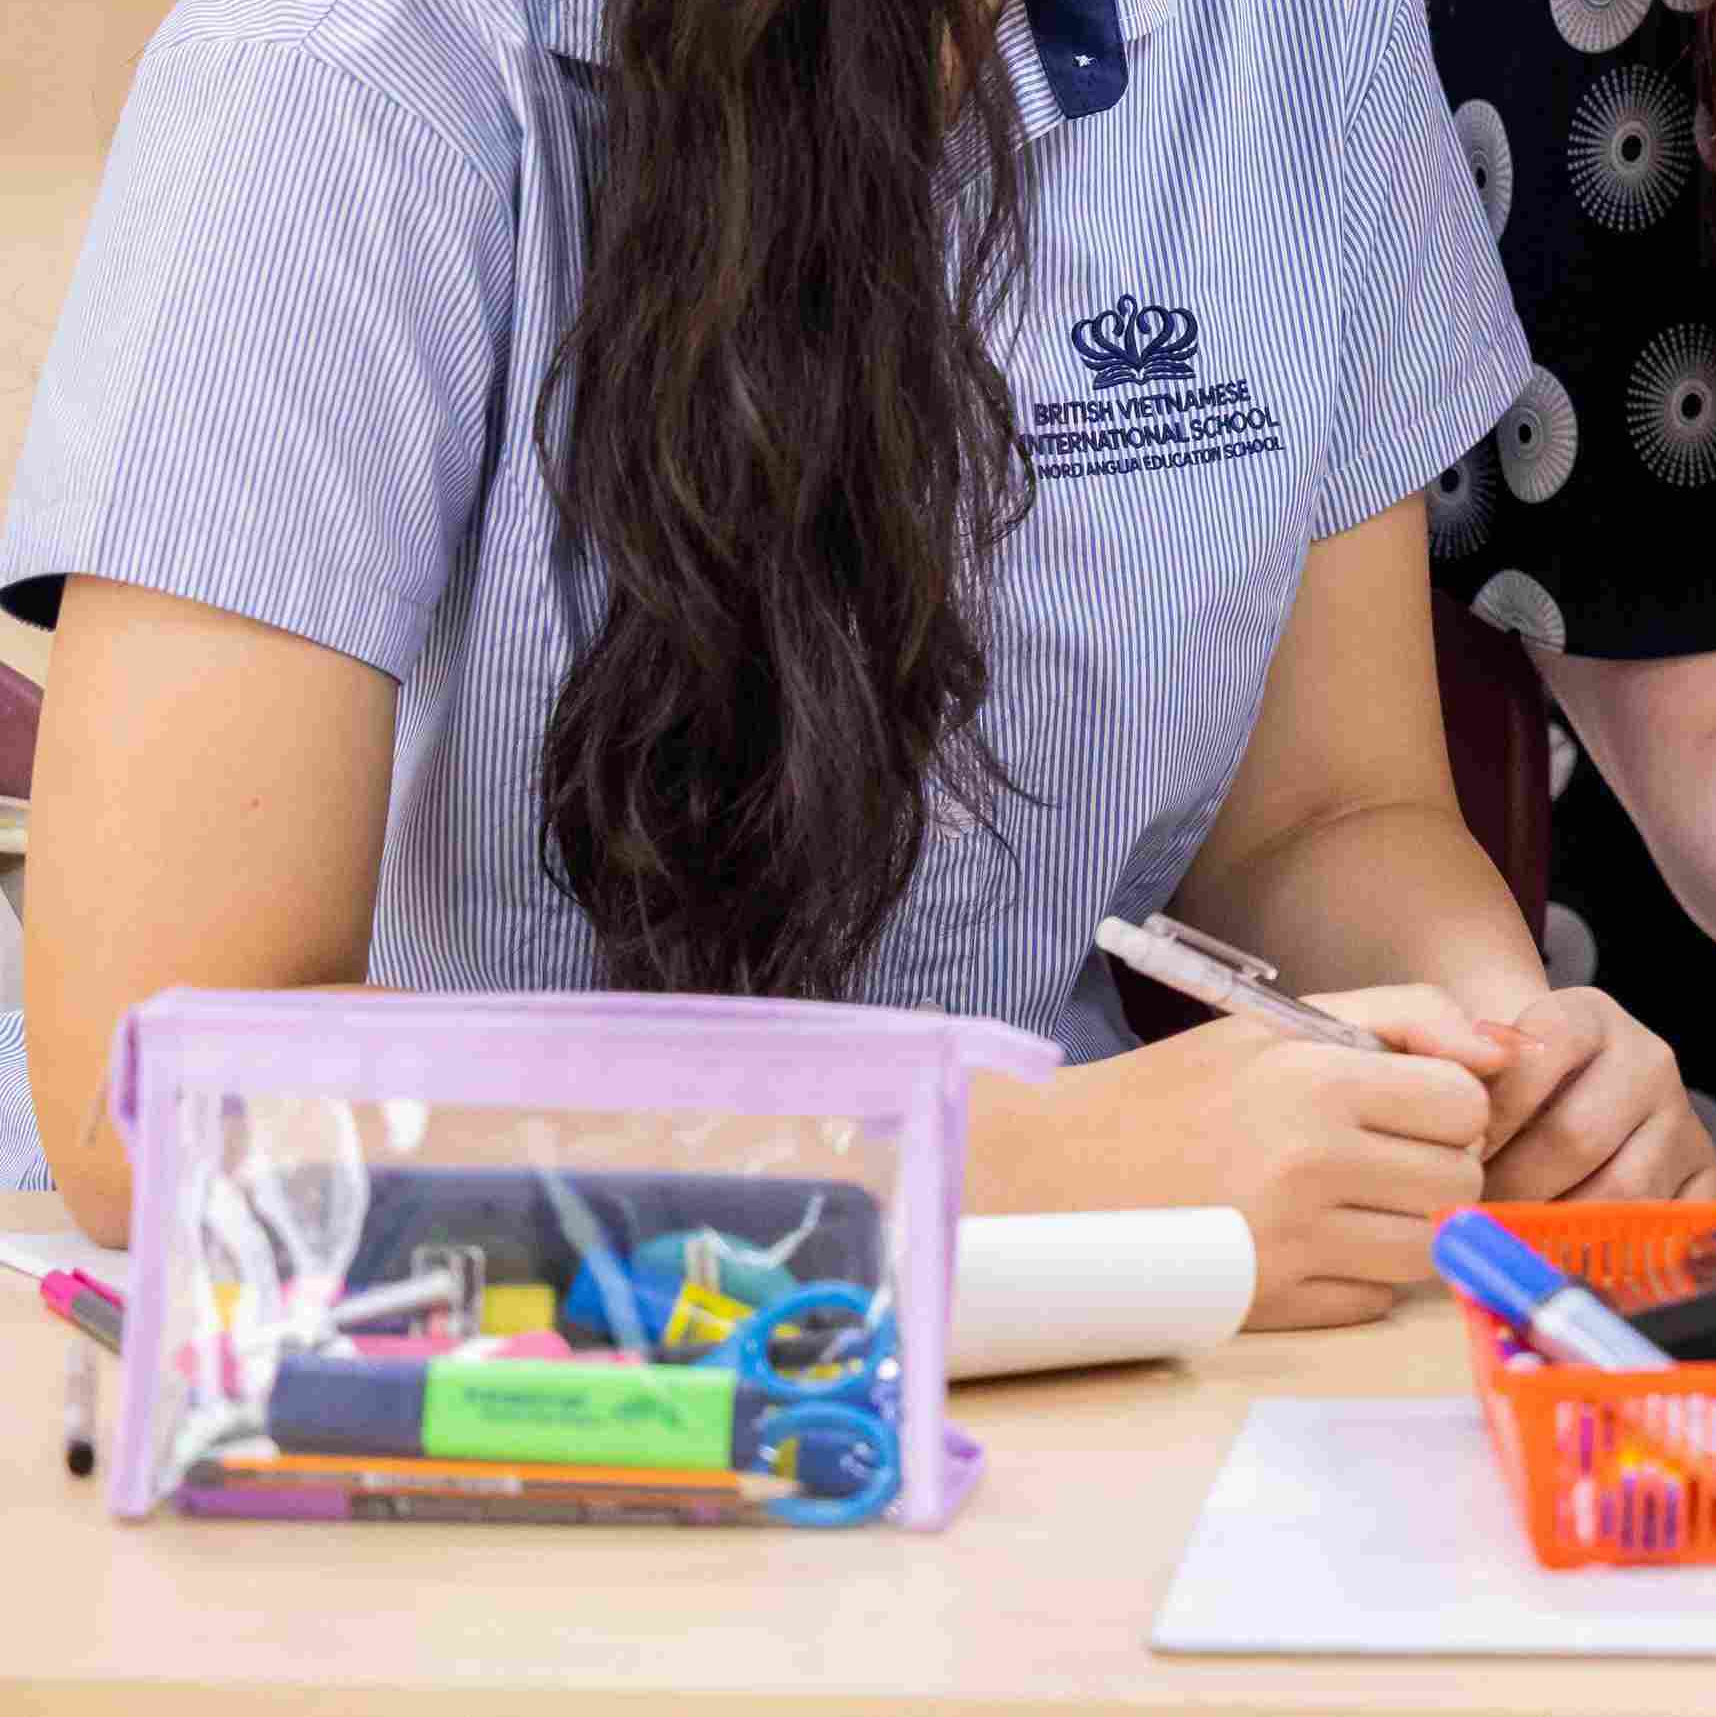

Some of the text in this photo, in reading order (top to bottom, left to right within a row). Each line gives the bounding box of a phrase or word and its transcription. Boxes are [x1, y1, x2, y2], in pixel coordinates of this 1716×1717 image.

[1034, 379, 1251, 426] BRITISH VIETNAMESE
[1190, 406, 1281, 441] SCHOOL
[1038, 436, 1286, 480] NORD ANGLIA EDUCATION SCHOOL
